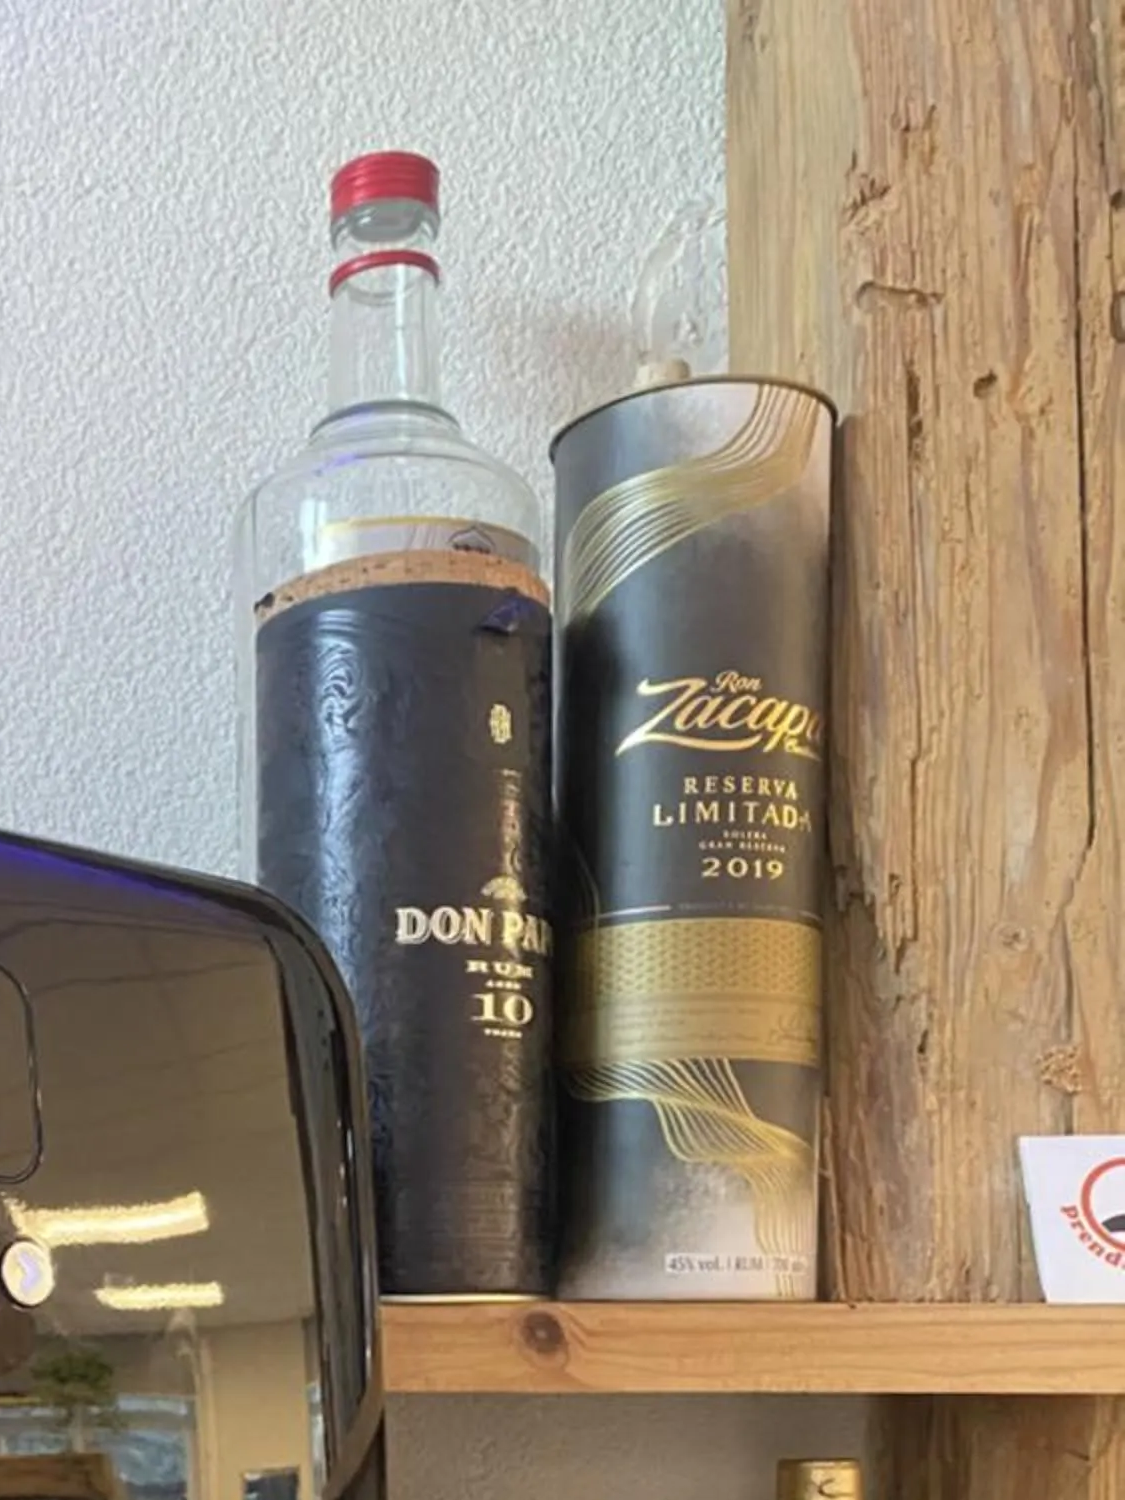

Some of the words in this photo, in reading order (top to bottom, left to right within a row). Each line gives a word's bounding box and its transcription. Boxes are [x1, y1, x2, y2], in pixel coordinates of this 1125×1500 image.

[711, 670, 762, 693] Ron
[683, 775, 797, 800] RESERVA
[652, 800, 812, 833] LIMITADA
[701, 857, 784, 880] 2019
[395, 905, 493, 946] DON
[465, 960, 533, 978] RUM
[470, 993, 534, 1025] 10
[1059, 1204, 1125, 1270] prend
